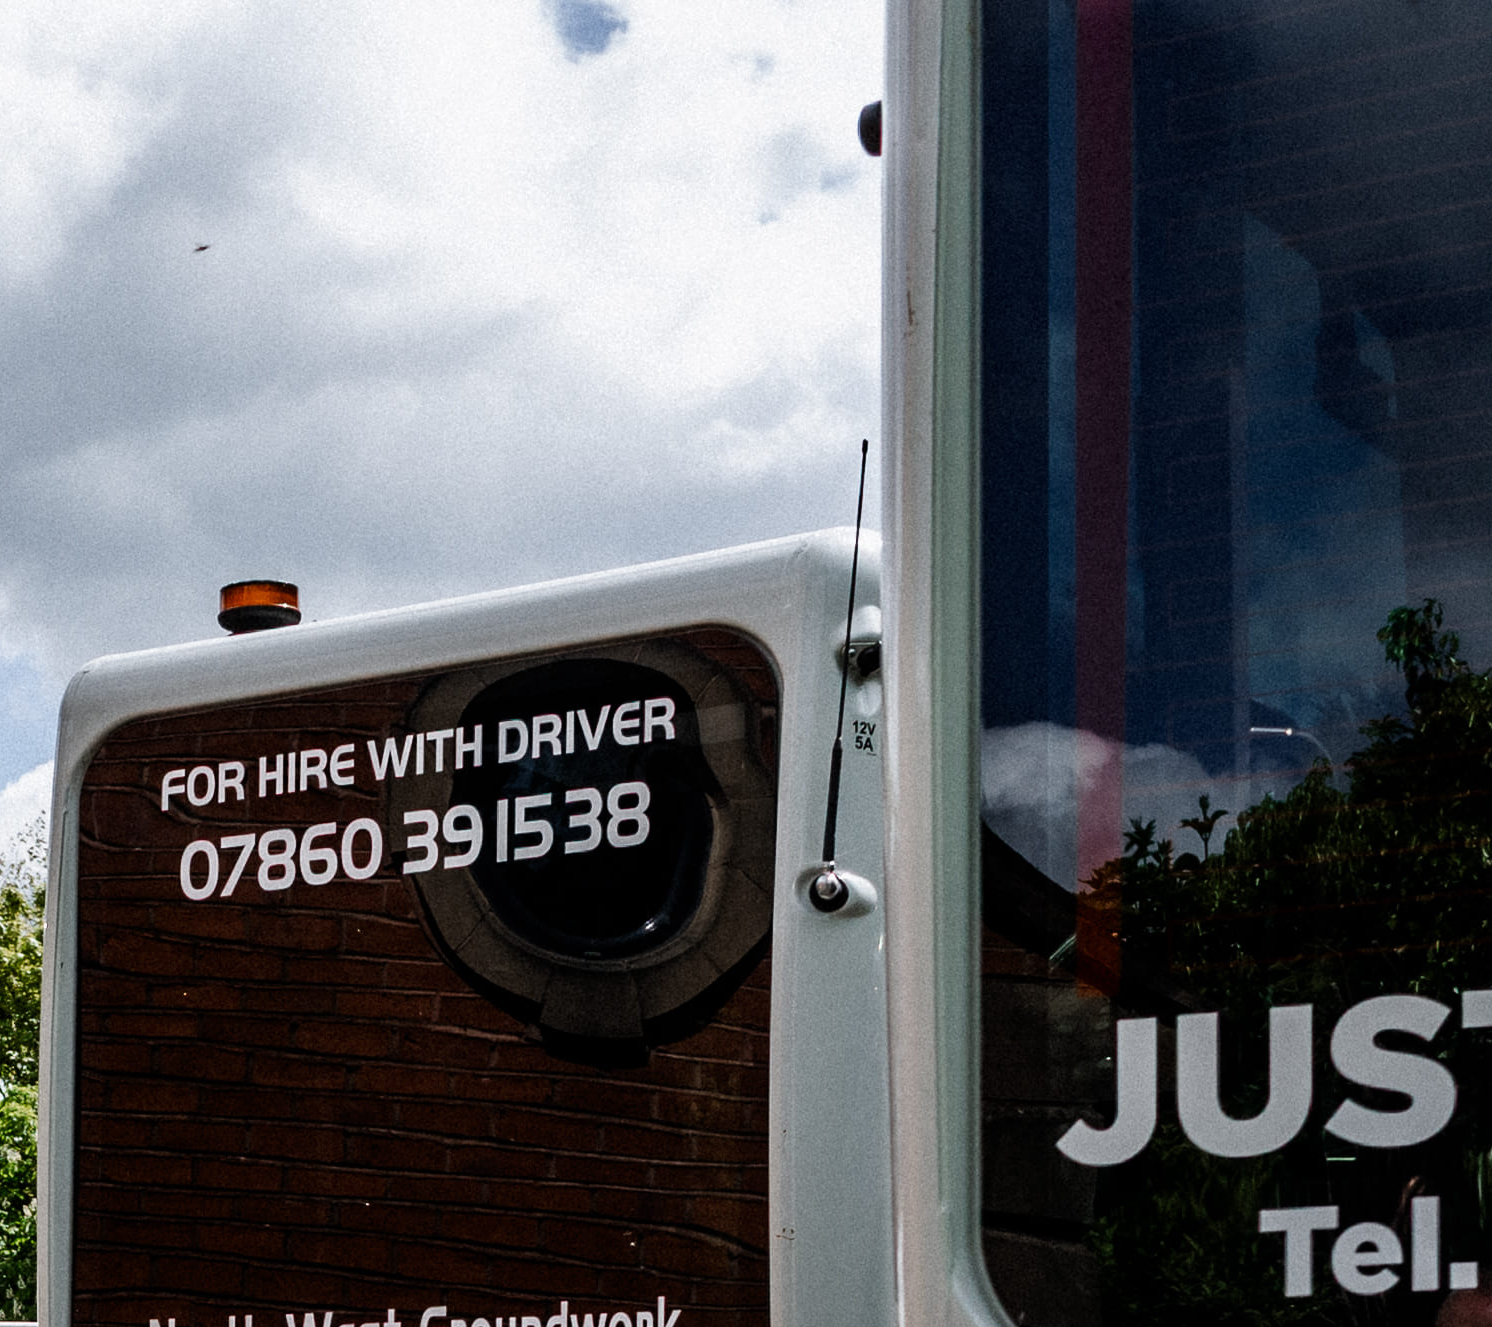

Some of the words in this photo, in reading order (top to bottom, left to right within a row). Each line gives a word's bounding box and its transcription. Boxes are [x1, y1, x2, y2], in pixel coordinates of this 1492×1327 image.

[161, 761, 245, 811] FOR
[258, 743, 355, 797] HIRE
[367, 724, 483, 781] WITH
[498, 697, 675, 763] DRIVER
[852, 720, 876, 735] 12V
[854, 736, 873, 752] 5A
[180, 817, 382, 900] 07860
[403, 781, 651, 875] 391538
[1259, 1196, 1478, 1298] Tel.
